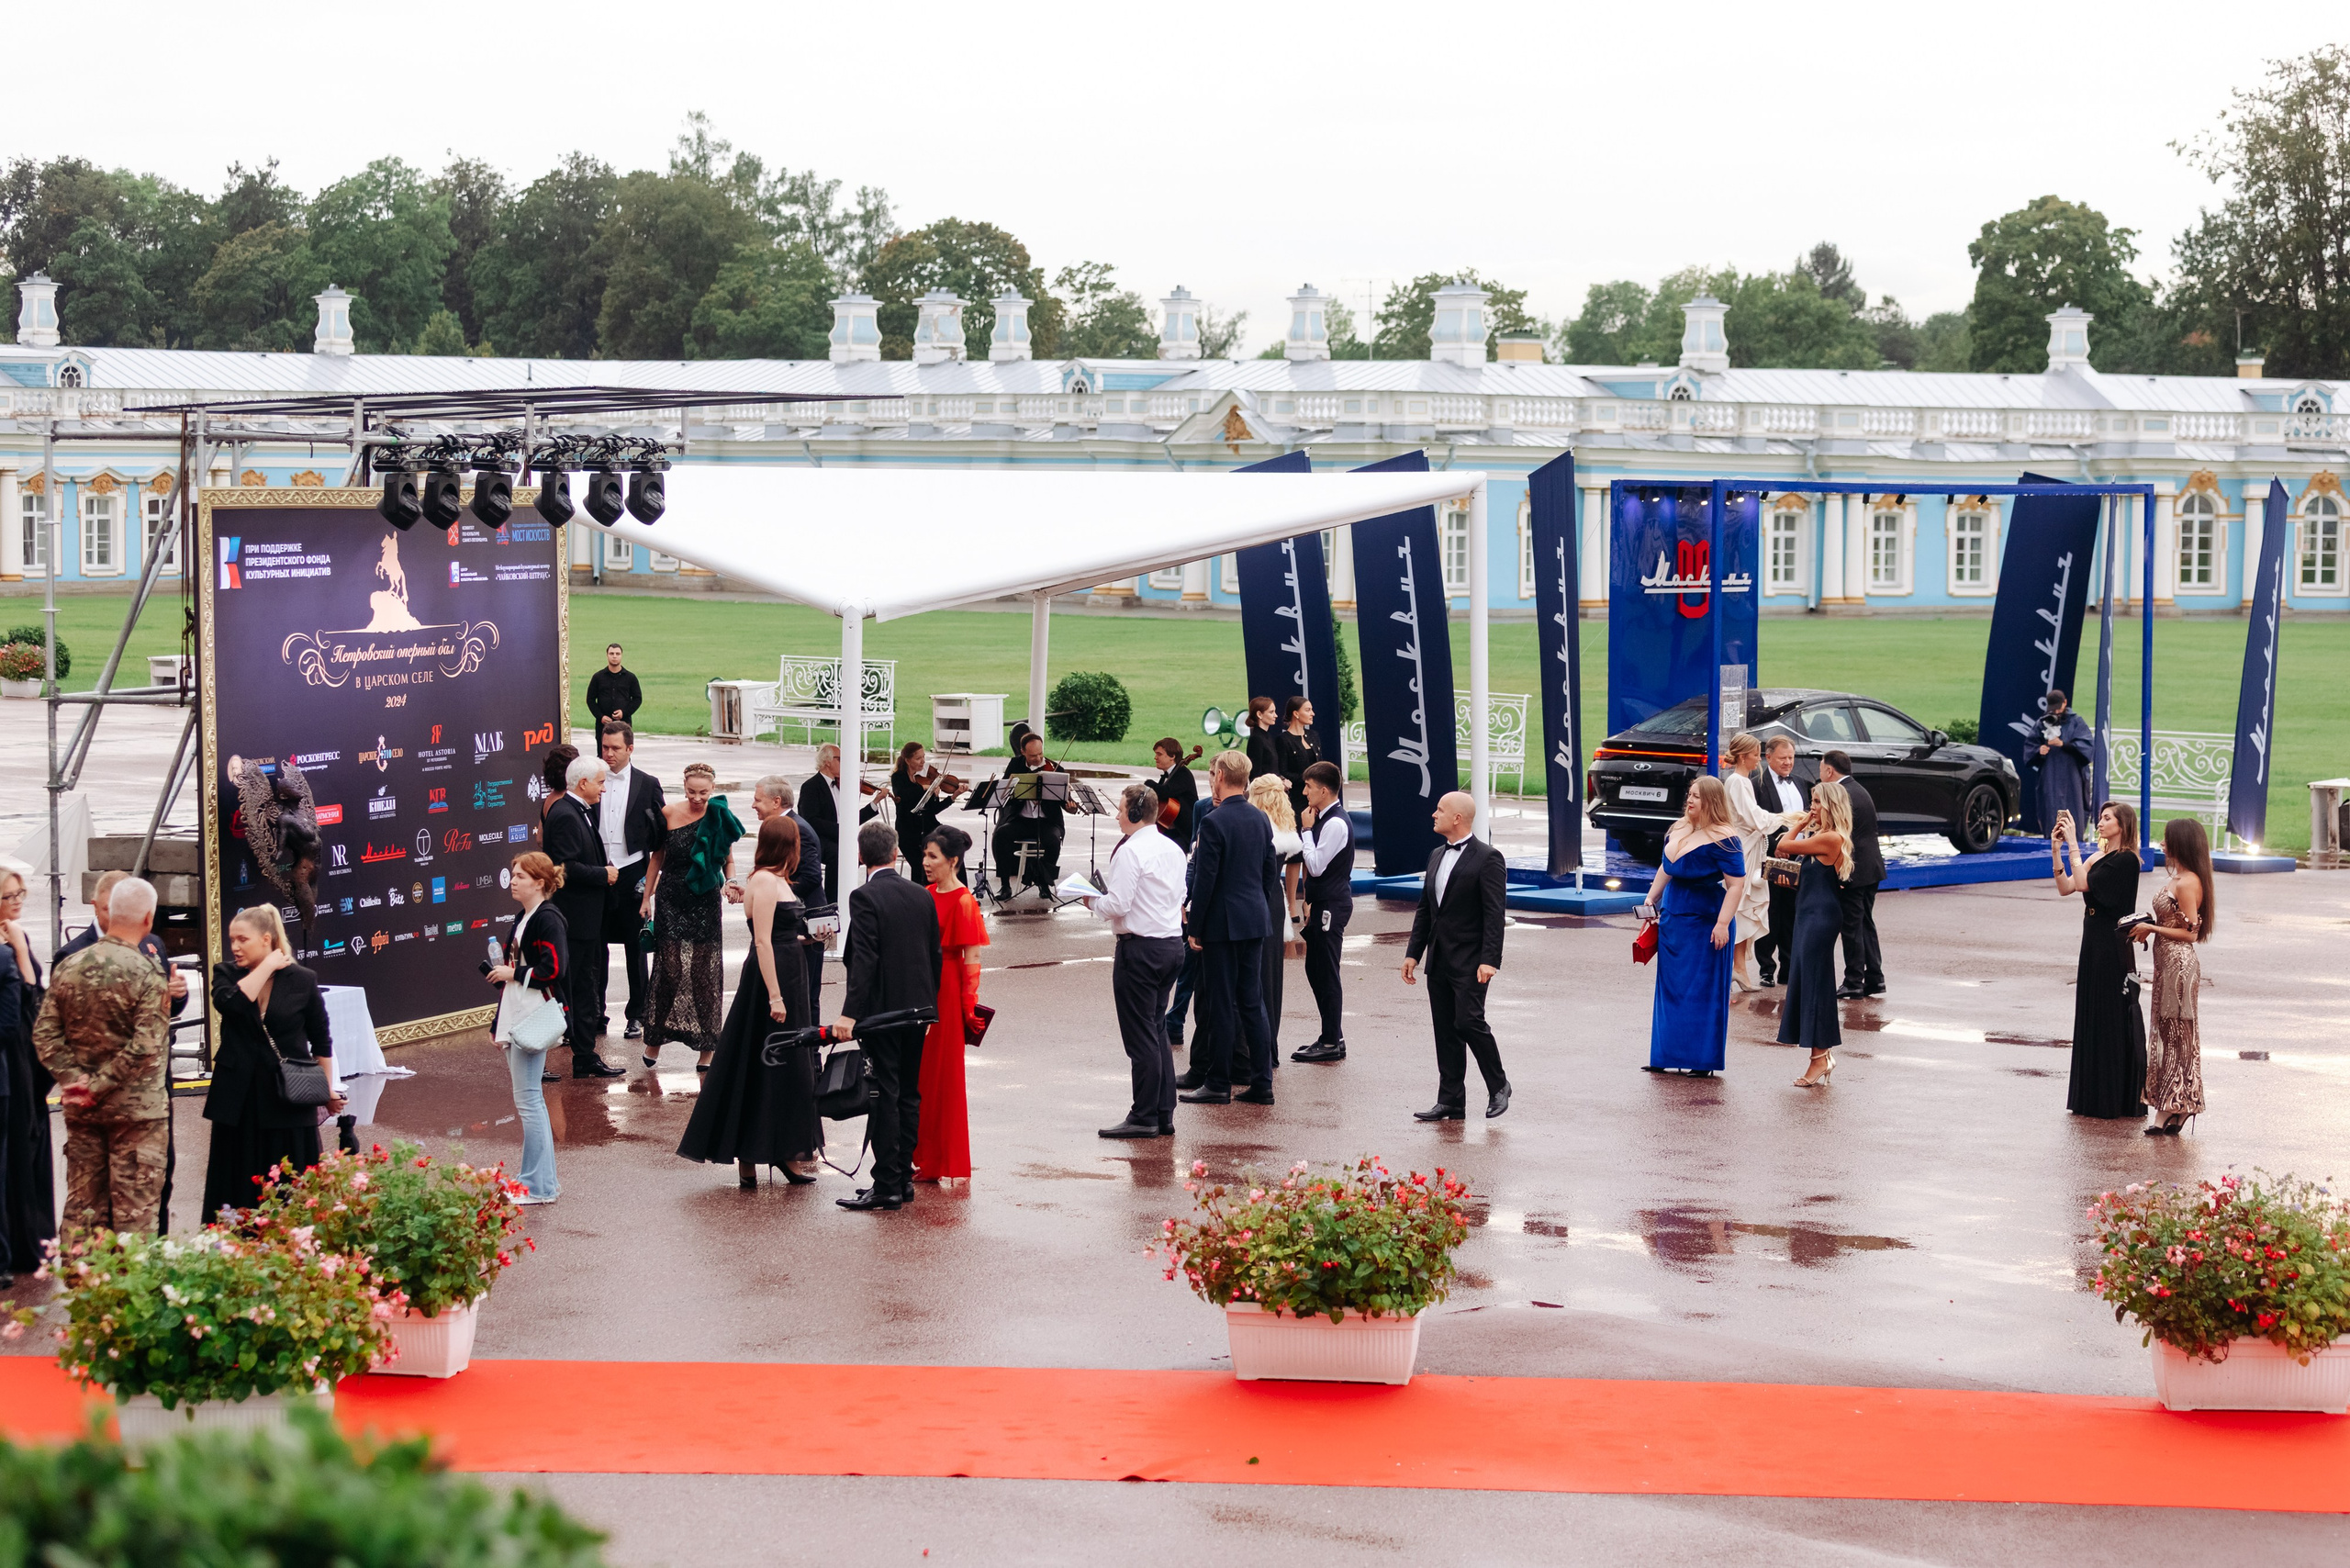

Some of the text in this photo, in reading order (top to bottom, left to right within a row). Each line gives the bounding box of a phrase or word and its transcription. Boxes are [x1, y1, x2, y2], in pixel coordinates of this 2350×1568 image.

[512, 529, 550, 542] МОСТ ИСКУССТВ
[245, 543, 302, 554] ПРИ ПОДДЕРЖКЕ
[245, 554, 330, 567] ПРЕЗИДЕНТСКОГО ФОНДА
[246, 567, 331, 579] КУЛЬТУРНЫХ ИНИЦИАТИВ
[1640, 551, 1751, 588] Москич
[330, 637, 455, 668] Петровский оперный бал
[356, 671, 433, 690] В ЦАРСКОМ СЕЛЕ
[385, 693, 407, 708] 2024
[297, 751, 340, 764] РОСКОНГРЕСС
[392, 748, 403, 757] СЕЛО
[434, 748, 456, 756] ASTORIA
[443, 828, 472, 854] ReFa
[479, 832, 503, 841] MOLECULE
[331, 845, 349, 867] NR
[447, 924, 463, 933] metro
